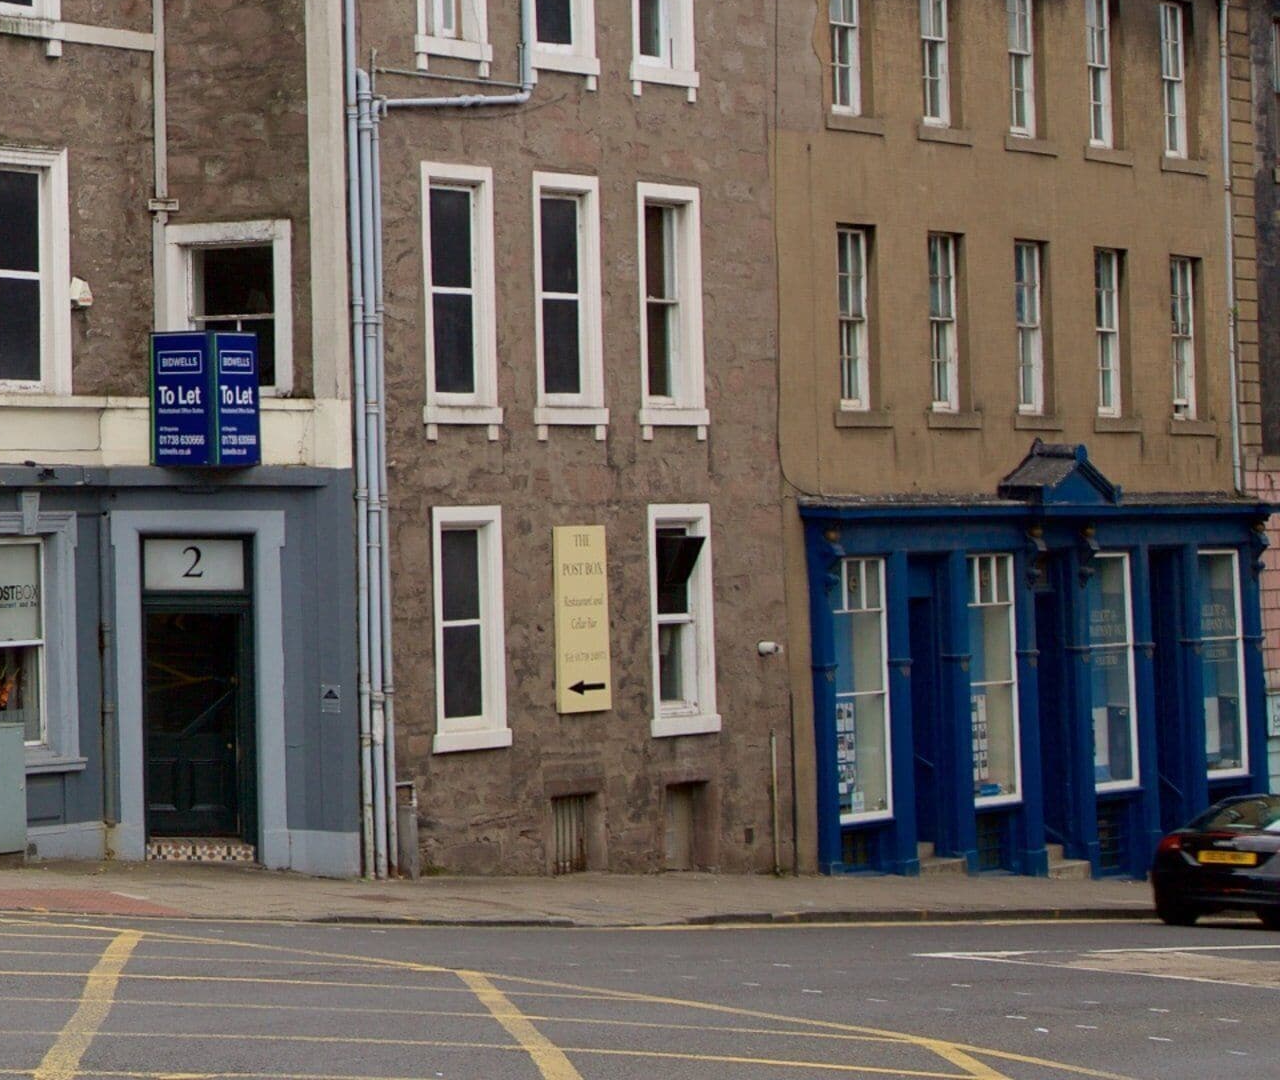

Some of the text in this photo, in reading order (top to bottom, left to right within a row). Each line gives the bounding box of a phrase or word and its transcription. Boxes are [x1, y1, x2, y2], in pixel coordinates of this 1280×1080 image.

[158, 385, 201, 405] To Let
[220, 385, 253, 405] To Let
[182, 546, 203, 577] 2
